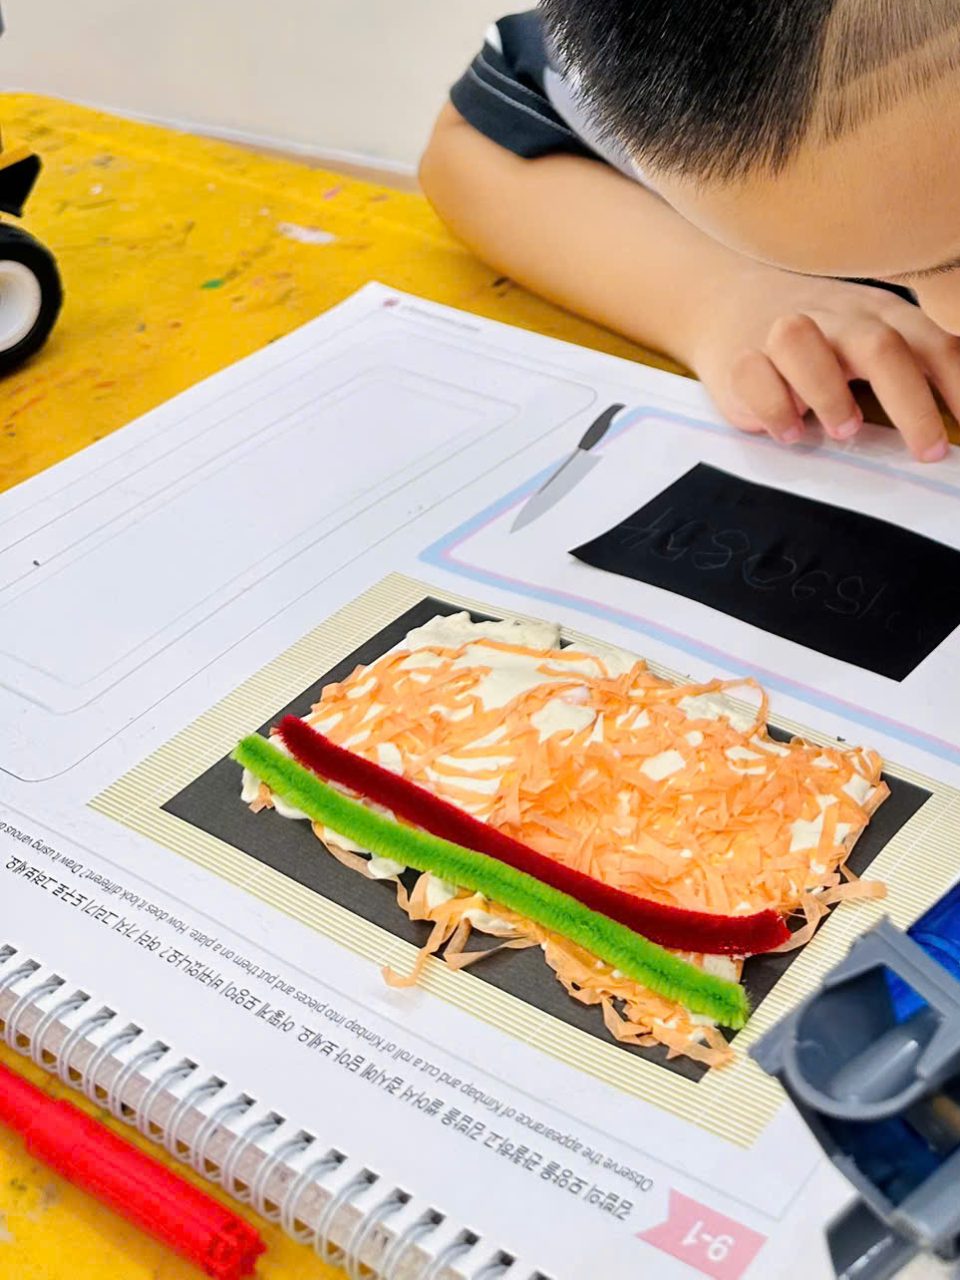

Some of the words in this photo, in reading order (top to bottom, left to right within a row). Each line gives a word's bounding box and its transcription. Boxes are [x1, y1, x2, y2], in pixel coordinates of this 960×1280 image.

[2, 825, 35, 847] various
[29, 838, 56, 859] using
[50, 851, 63, 864] it
[57, 854, 84, 875] Draw
[77, 868, 124, 896] different?
[51, 882, 89, 908] 도구로
[117, 888, 142, 908] look
[135, 899, 149, 912] it
[80, 898, 120, 926] 그리기
[143, 903, 170, 922] does
[110, 916, 141, 940] 가지
[165, 916, 190, 936] How
[133, 929, 162, 952] 여러
[188, 928, 219, 950] plate.
[210, 943, 223, 953] a
[218, 947, 236, 960] on
[158, 945, 225, 991] 바뀌었나요?
[231, 954, 261, 976] them
[255, 968, 281, 986] put
[270, 979, 297, 996] and
[218, 980, 263, 1012] 모양이
[291, 990, 330, 1014] pieces
[253, 1001, 296, 1033] 어떻게
[319, 1008, 348, 1029] into
[343, 1018, 386, 1049] Kimbap
[377, 1041, 398, 1053] of
[390, 1048, 415, 1064] roll
[332, 1047, 367, 1074] 담아
[411, 1057, 424, 1068] a
[419, 1061, 441, 1078] cut
[358, 1062, 405, 1096] 접시에
[434, 1071, 463, 1089] and
[397, 1084, 446, 1117] 썰어서
[459, 1082, 504, 1114] Kimbap
[497, 1106, 517, 1119] of
[440, 1106, 487, 1142] 김밥을
[514, 1112, 584, 1154] appearance
[482, 1130, 544, 1172] 관찰하고
[580, 1146, 604, 1166] the
[539, 1160, 589, 1196] 모양을
[602, 1157, 654, 1193] Observe
[582, 1183, 634, 1222] 김밥의
[682, 1220, 735, 1261] 9-1
